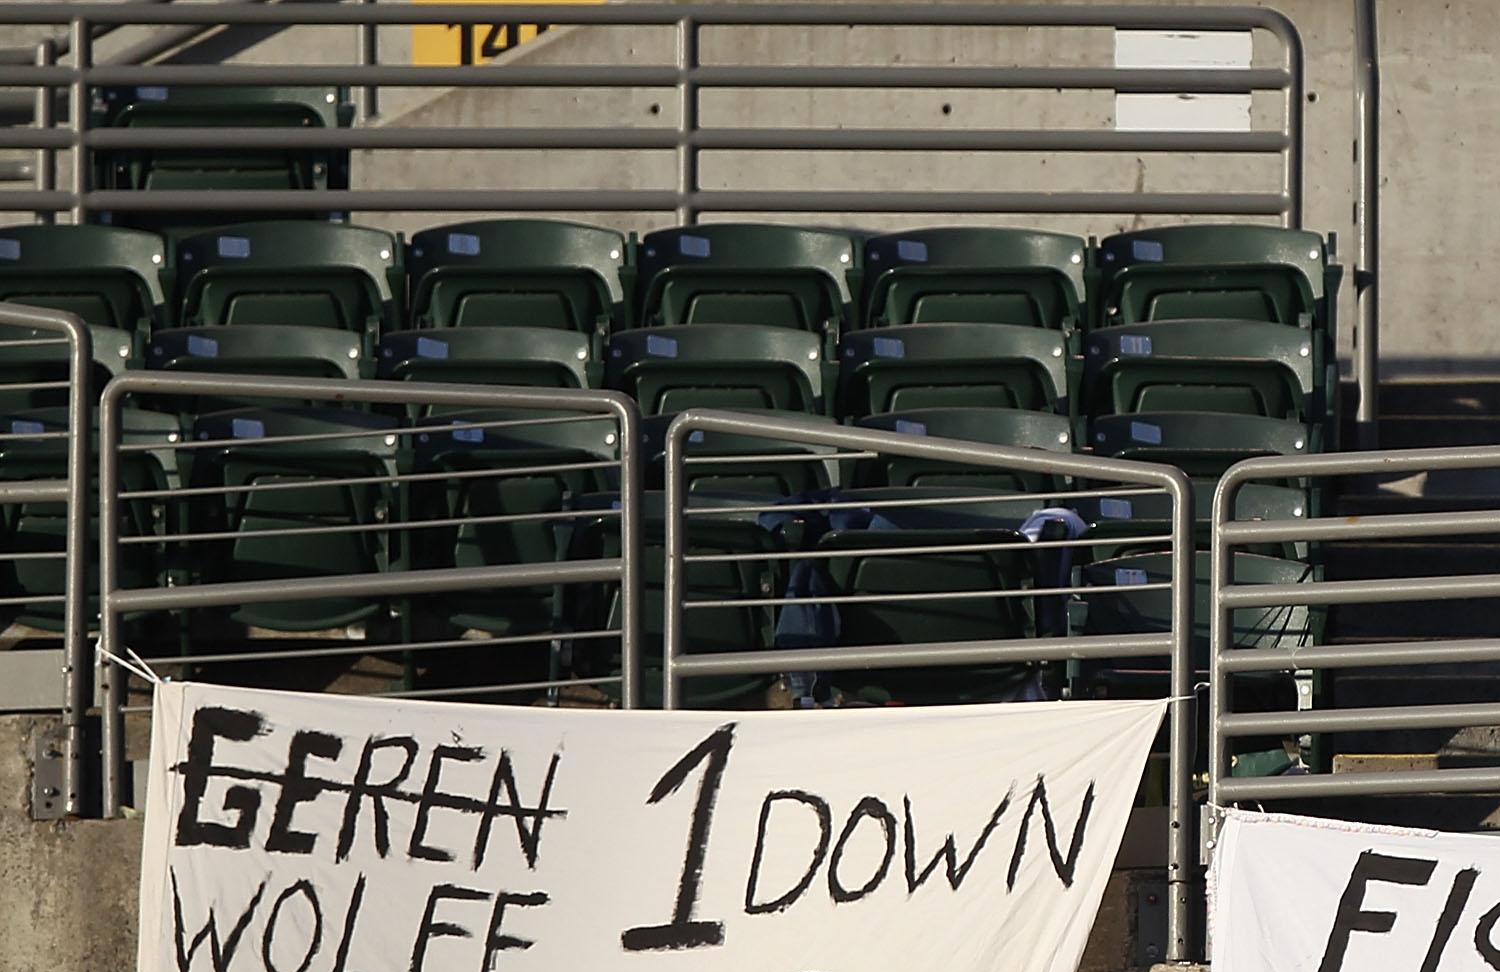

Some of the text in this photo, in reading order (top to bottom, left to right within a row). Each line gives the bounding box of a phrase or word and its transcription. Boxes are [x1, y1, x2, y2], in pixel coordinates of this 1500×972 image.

[170, 706, 1102, 951] GEREN 1 DOWN
